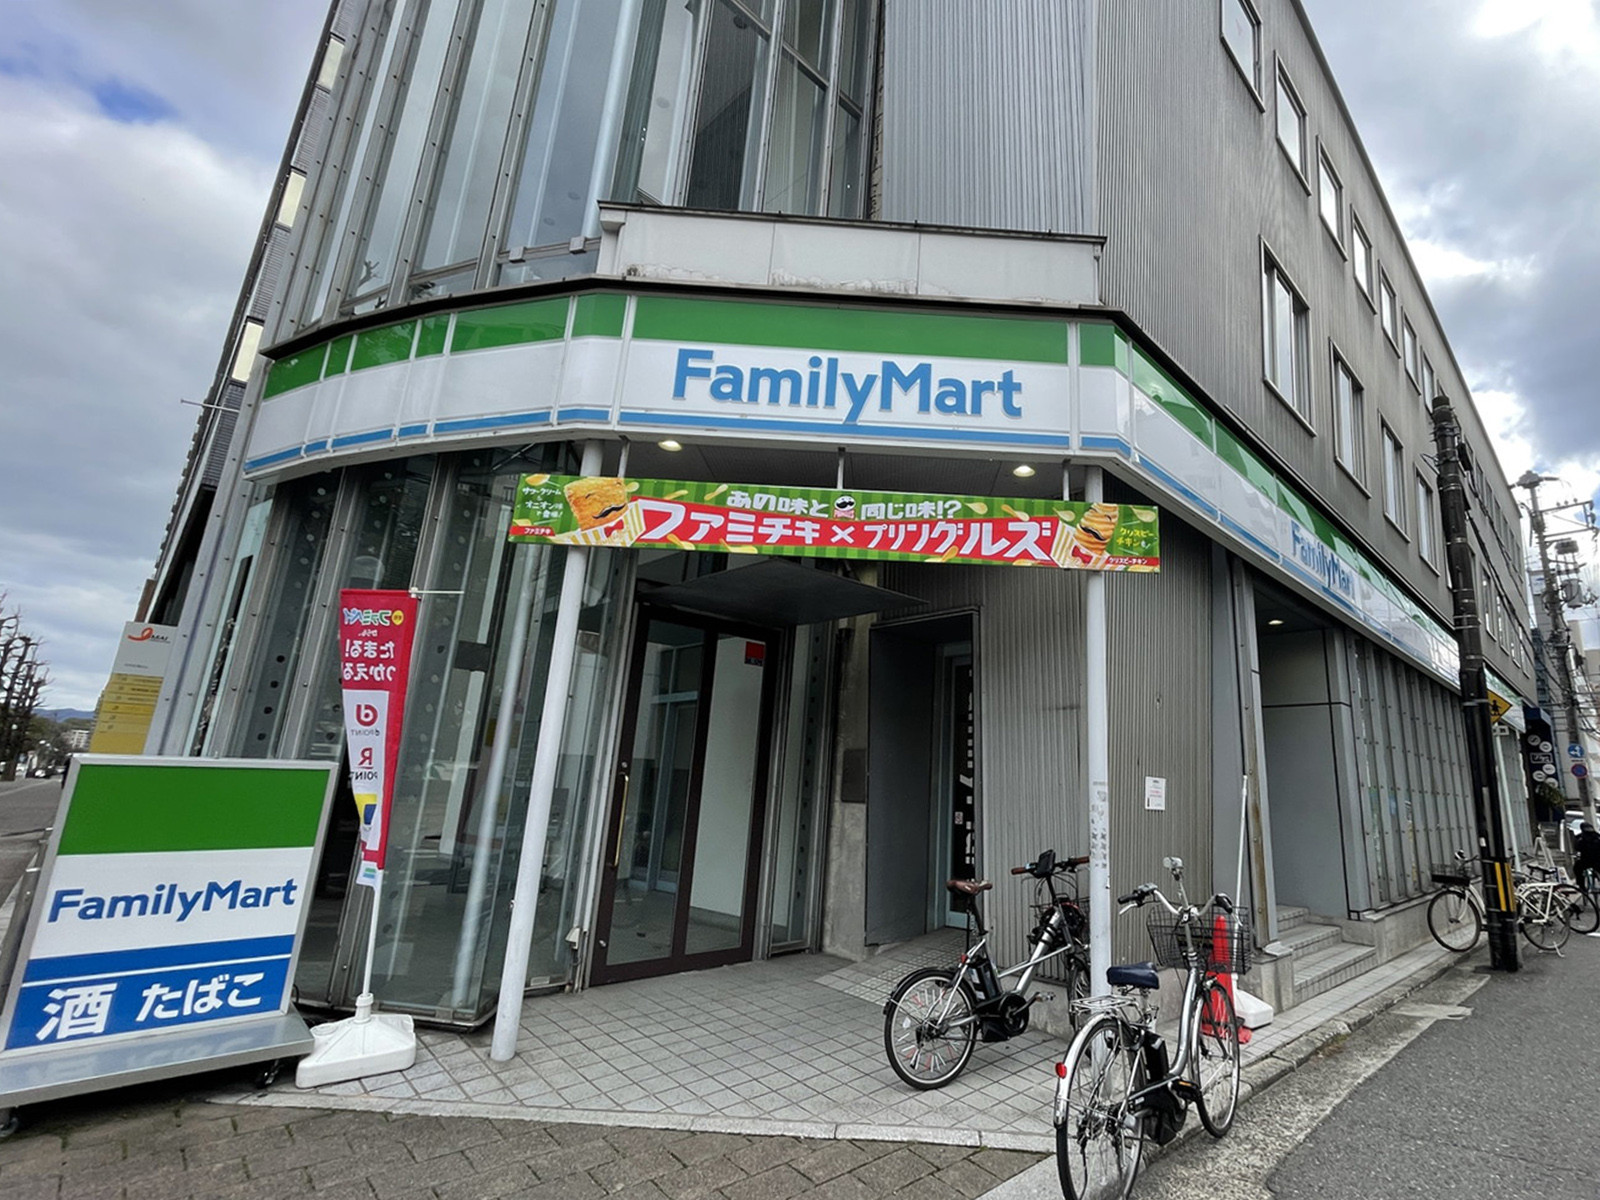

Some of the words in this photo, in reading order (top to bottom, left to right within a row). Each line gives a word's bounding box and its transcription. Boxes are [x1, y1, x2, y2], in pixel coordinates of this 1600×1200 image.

[672, 348, 1022, 426] FamilyMart
[639, 499, 821, 544] ファミチキ
[864, 520, 1052, 561] プリングルズ
[726, 491, 829, 517] あの味と
[861, 500, 962, 520] 同じ味!?
[1291, 520, 1357, 602] FamilyMart
[48, 878, 298, 922] FamilyMart
[36, 982, 117, 1041] 酒
[136, 972, 264, 1022] たばこ
